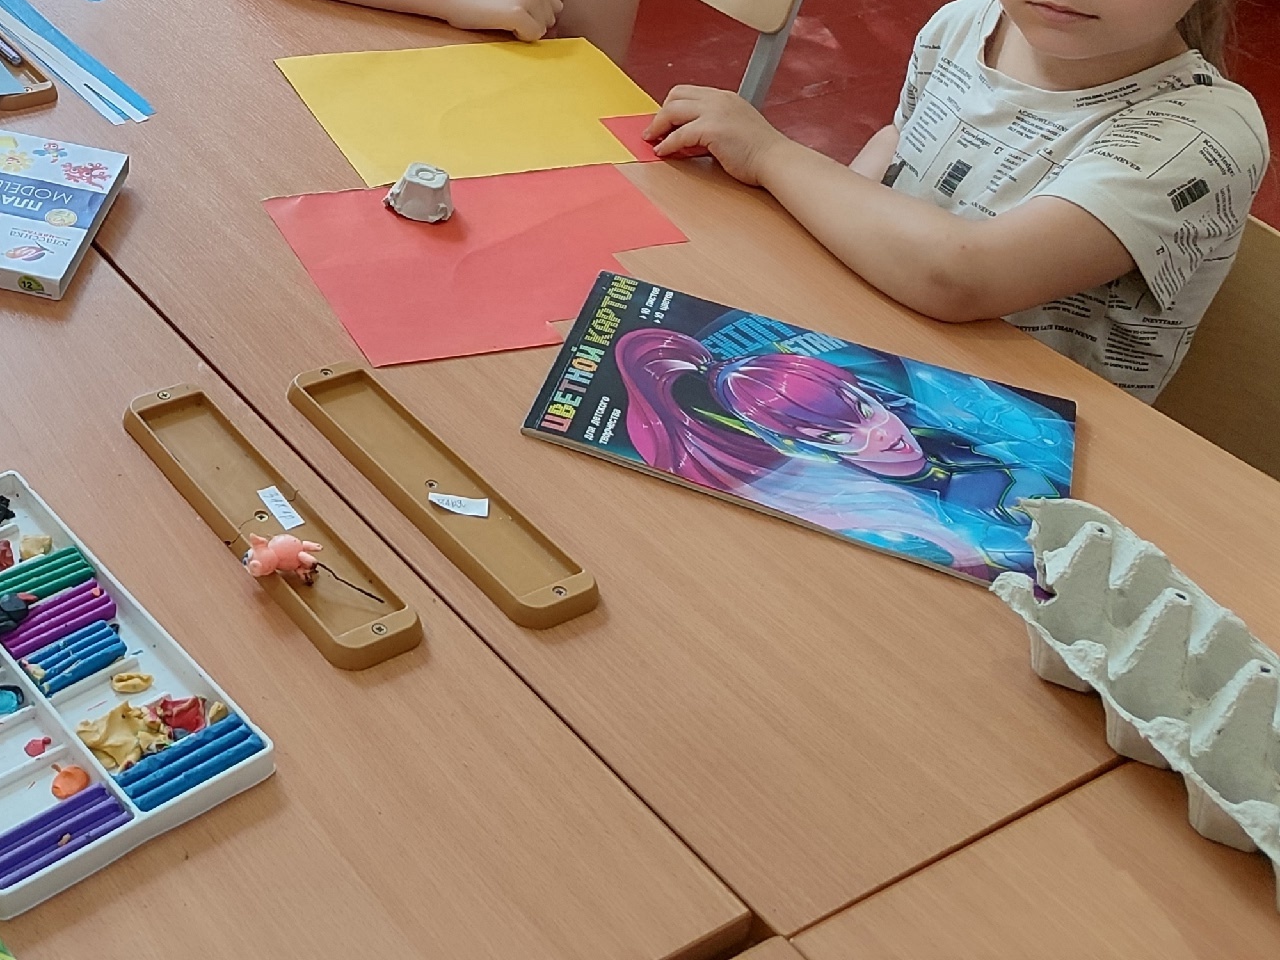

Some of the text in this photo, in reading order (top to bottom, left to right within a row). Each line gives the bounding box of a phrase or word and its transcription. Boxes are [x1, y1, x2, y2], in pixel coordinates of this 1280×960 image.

[20, 280, 33, 290] 12
[540, 275, 639, 433] ЦВЕТНОЙ КАРТОН
[583, 396, 611, 441] для детского
[599, 408, 622, 445] творчества
